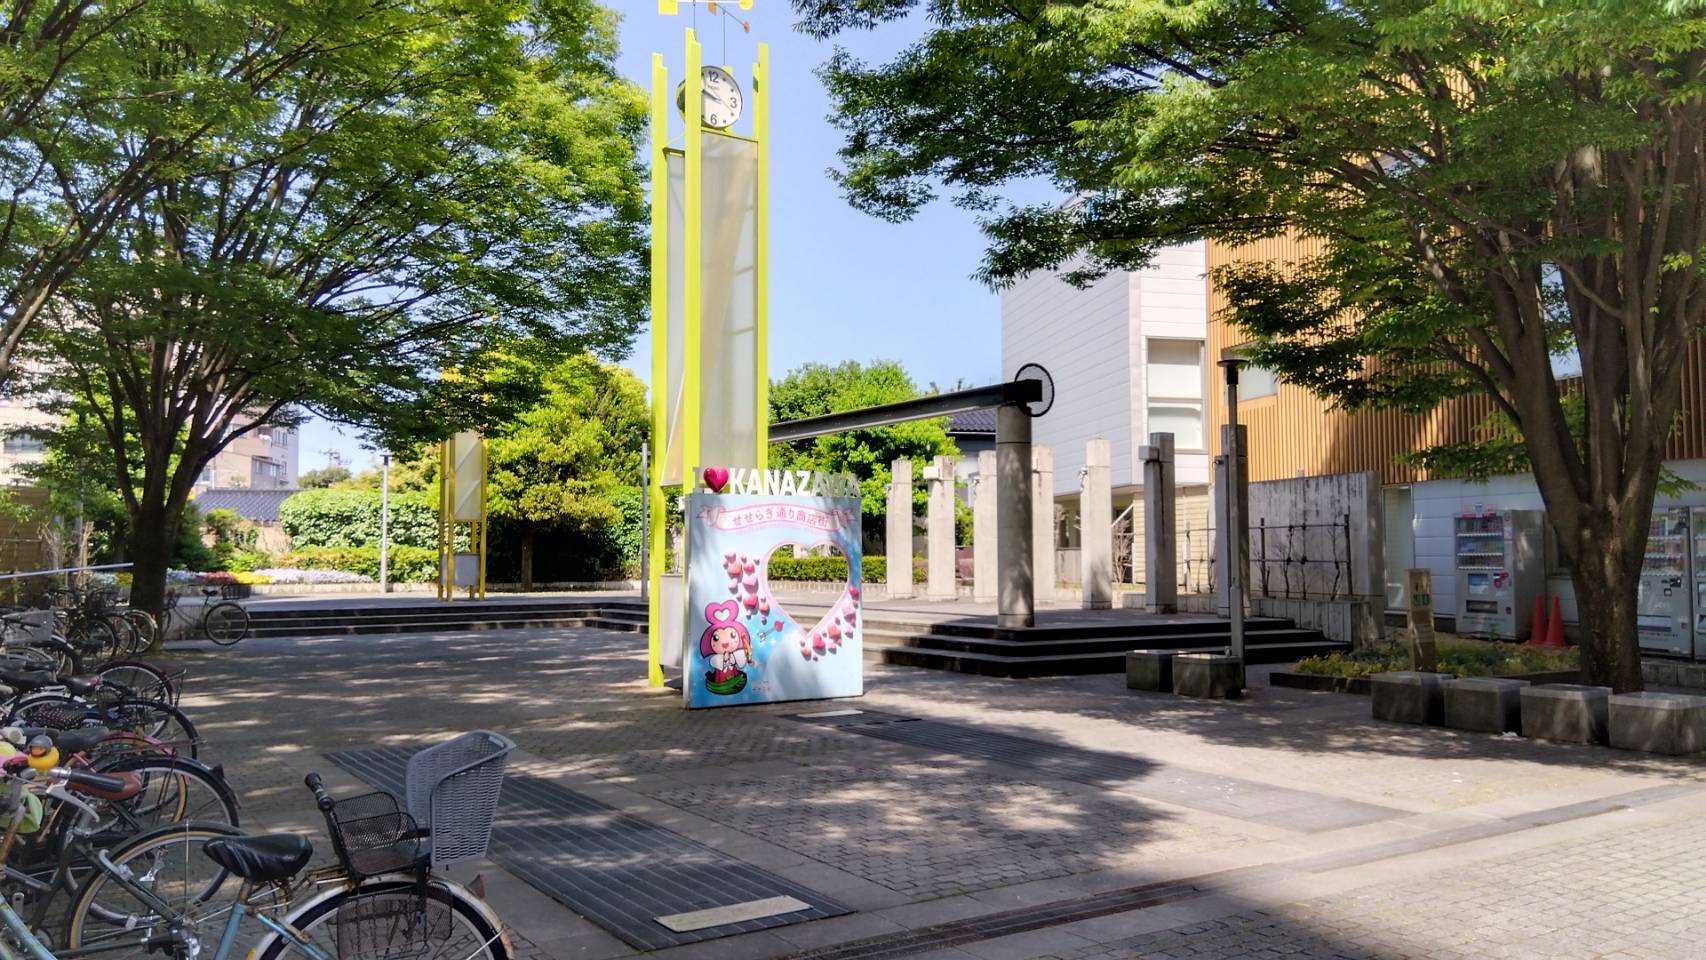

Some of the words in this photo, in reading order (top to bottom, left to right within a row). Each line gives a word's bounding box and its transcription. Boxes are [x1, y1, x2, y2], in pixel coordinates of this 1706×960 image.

[708, 71, 719, 83] 12
[730, 97, 738, 109] 3
[710, 113, 718, 125] 6
[693, 467, 703, 494] I
[730, 468, 862, 497] KANAZAWA
[732, 507, 829, 527] せせらぎ通り商店街
